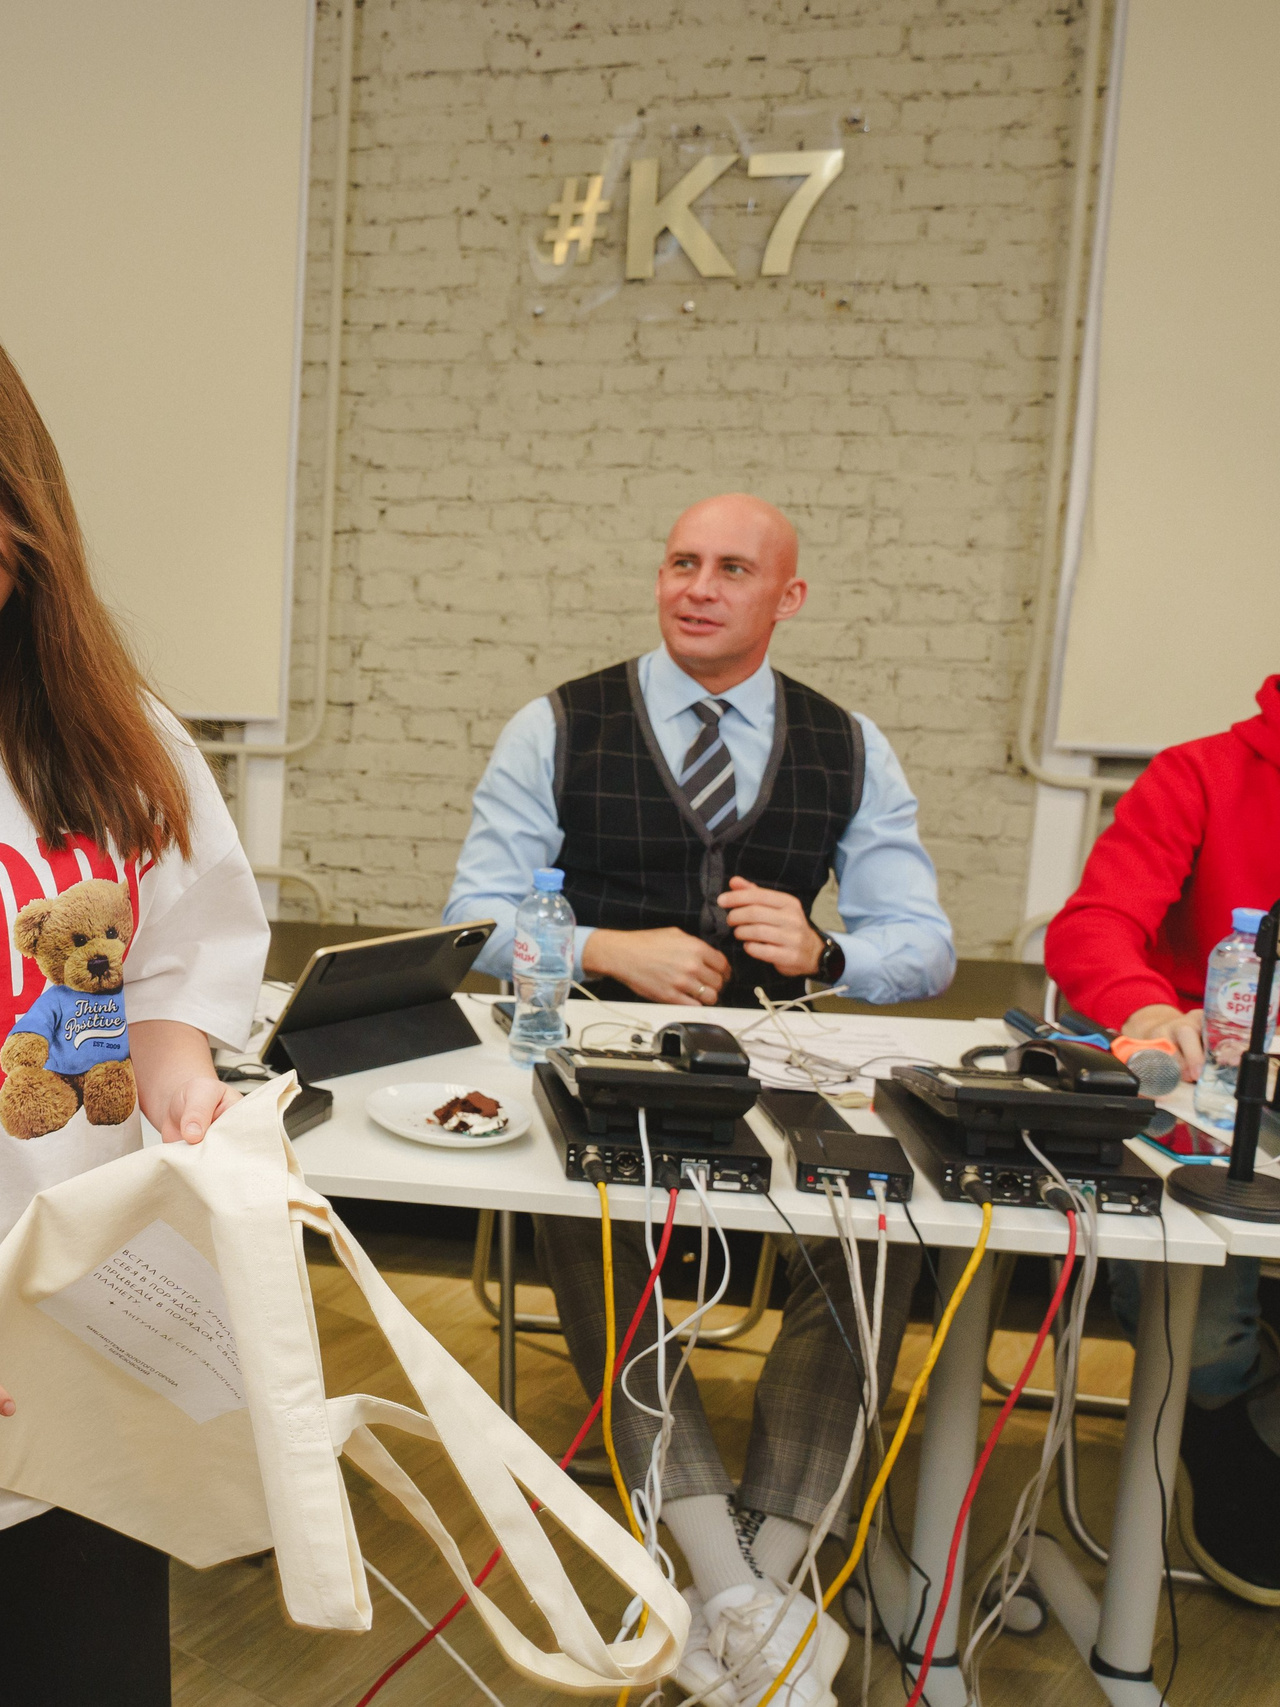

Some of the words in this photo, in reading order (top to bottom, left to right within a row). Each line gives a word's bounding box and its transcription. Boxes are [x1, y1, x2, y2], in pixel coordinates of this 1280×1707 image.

[543, 148, 845, 280] #K7
[64, 1013, 123, 1041] Positive
[75, 999, 119, 1018] Think
[106, 1042, 121, 1050] 2009
[113, 1258, 138, 1277] СЕБЯ
[149, 1282, 200, 1318] ПОРЯДОК
[122, 1249, 157, 1276] ВСТАЛ
[206, 1309, 237, 1346] УМЫЛС
[103, 1264, 154, 1302] ПРИВЕДИ
[165, 1307, 215, 1342] ПОРЯДОК
[217, 1344, 242, 1375] СВОЮ
[122, 1309, 159, 1334] АНТУАН
[159, 1333, 174, 1342] ДЕ
